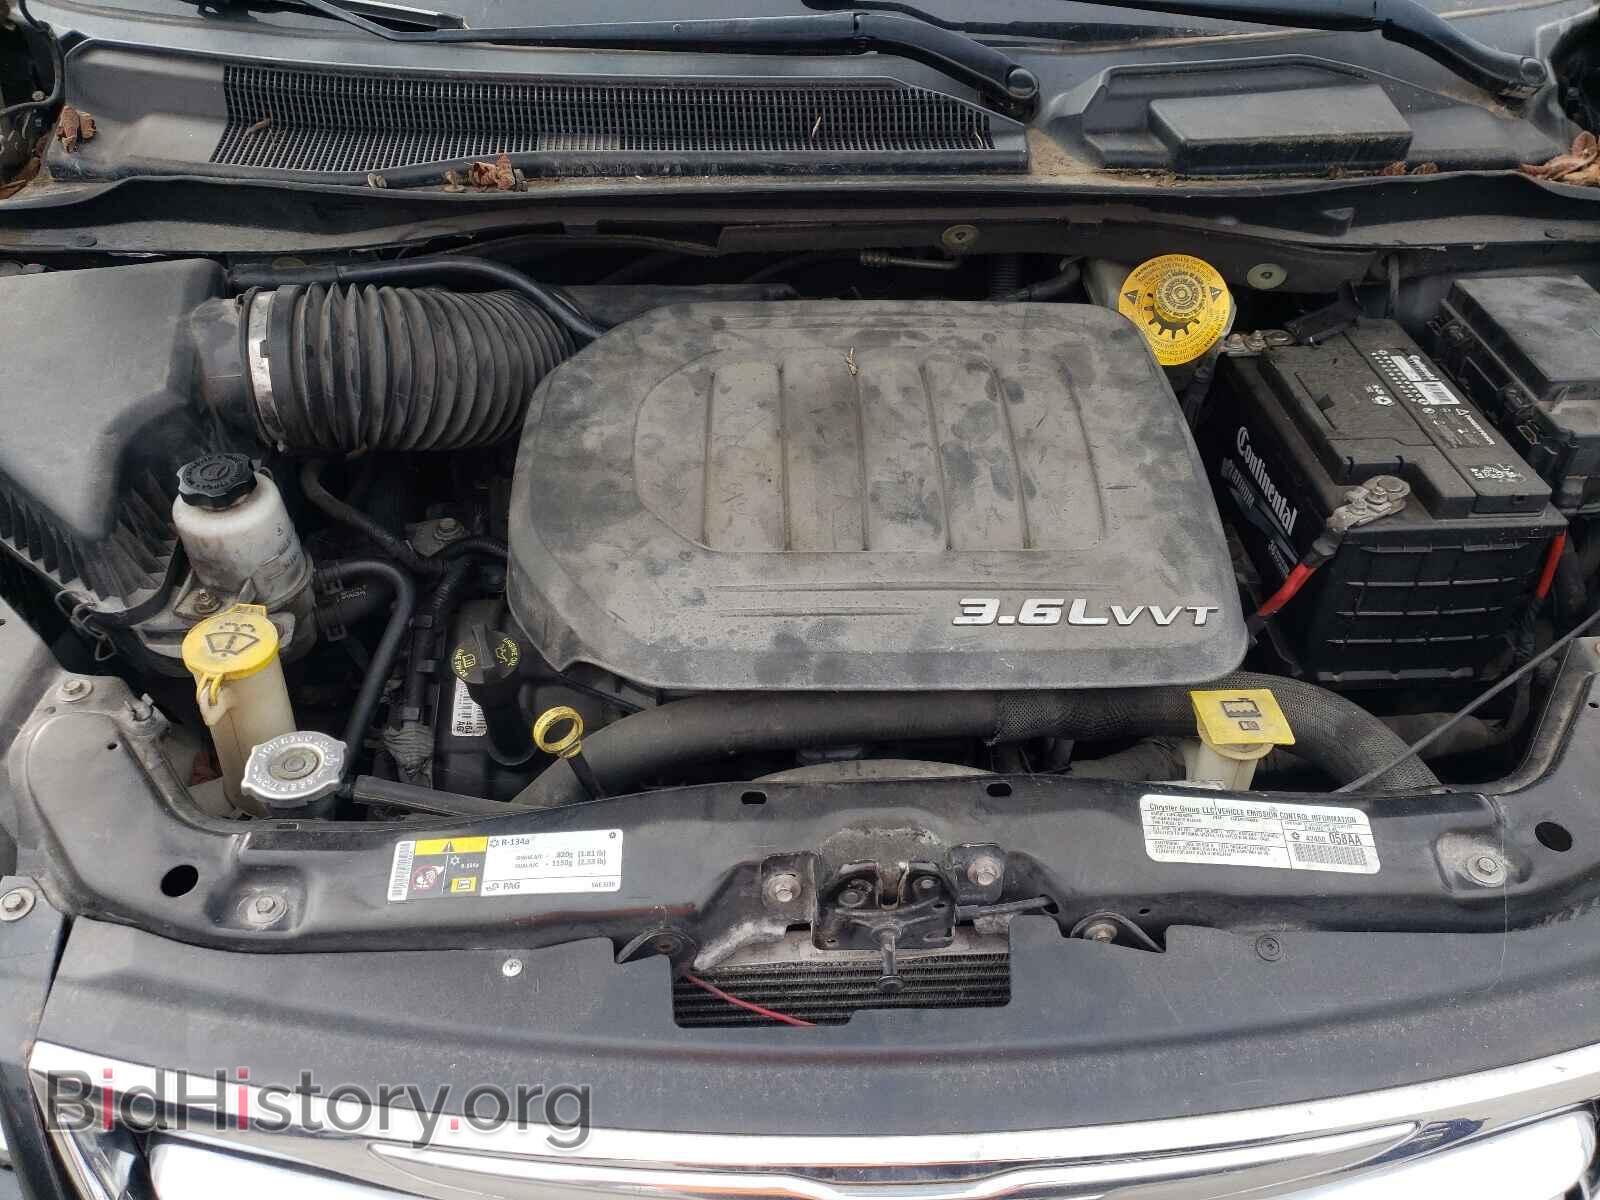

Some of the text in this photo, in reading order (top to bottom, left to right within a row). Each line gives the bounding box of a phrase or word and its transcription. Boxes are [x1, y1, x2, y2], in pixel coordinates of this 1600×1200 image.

[1236, 426, 1298, 537] Continental
[1149, 803, 1357, 824] Chrysler Group LLC VEHICLE EMISSION CONTROL INFORMATION
[501, 838, 530, 846] R-134a
[503, 882, 521, 890] PAG
